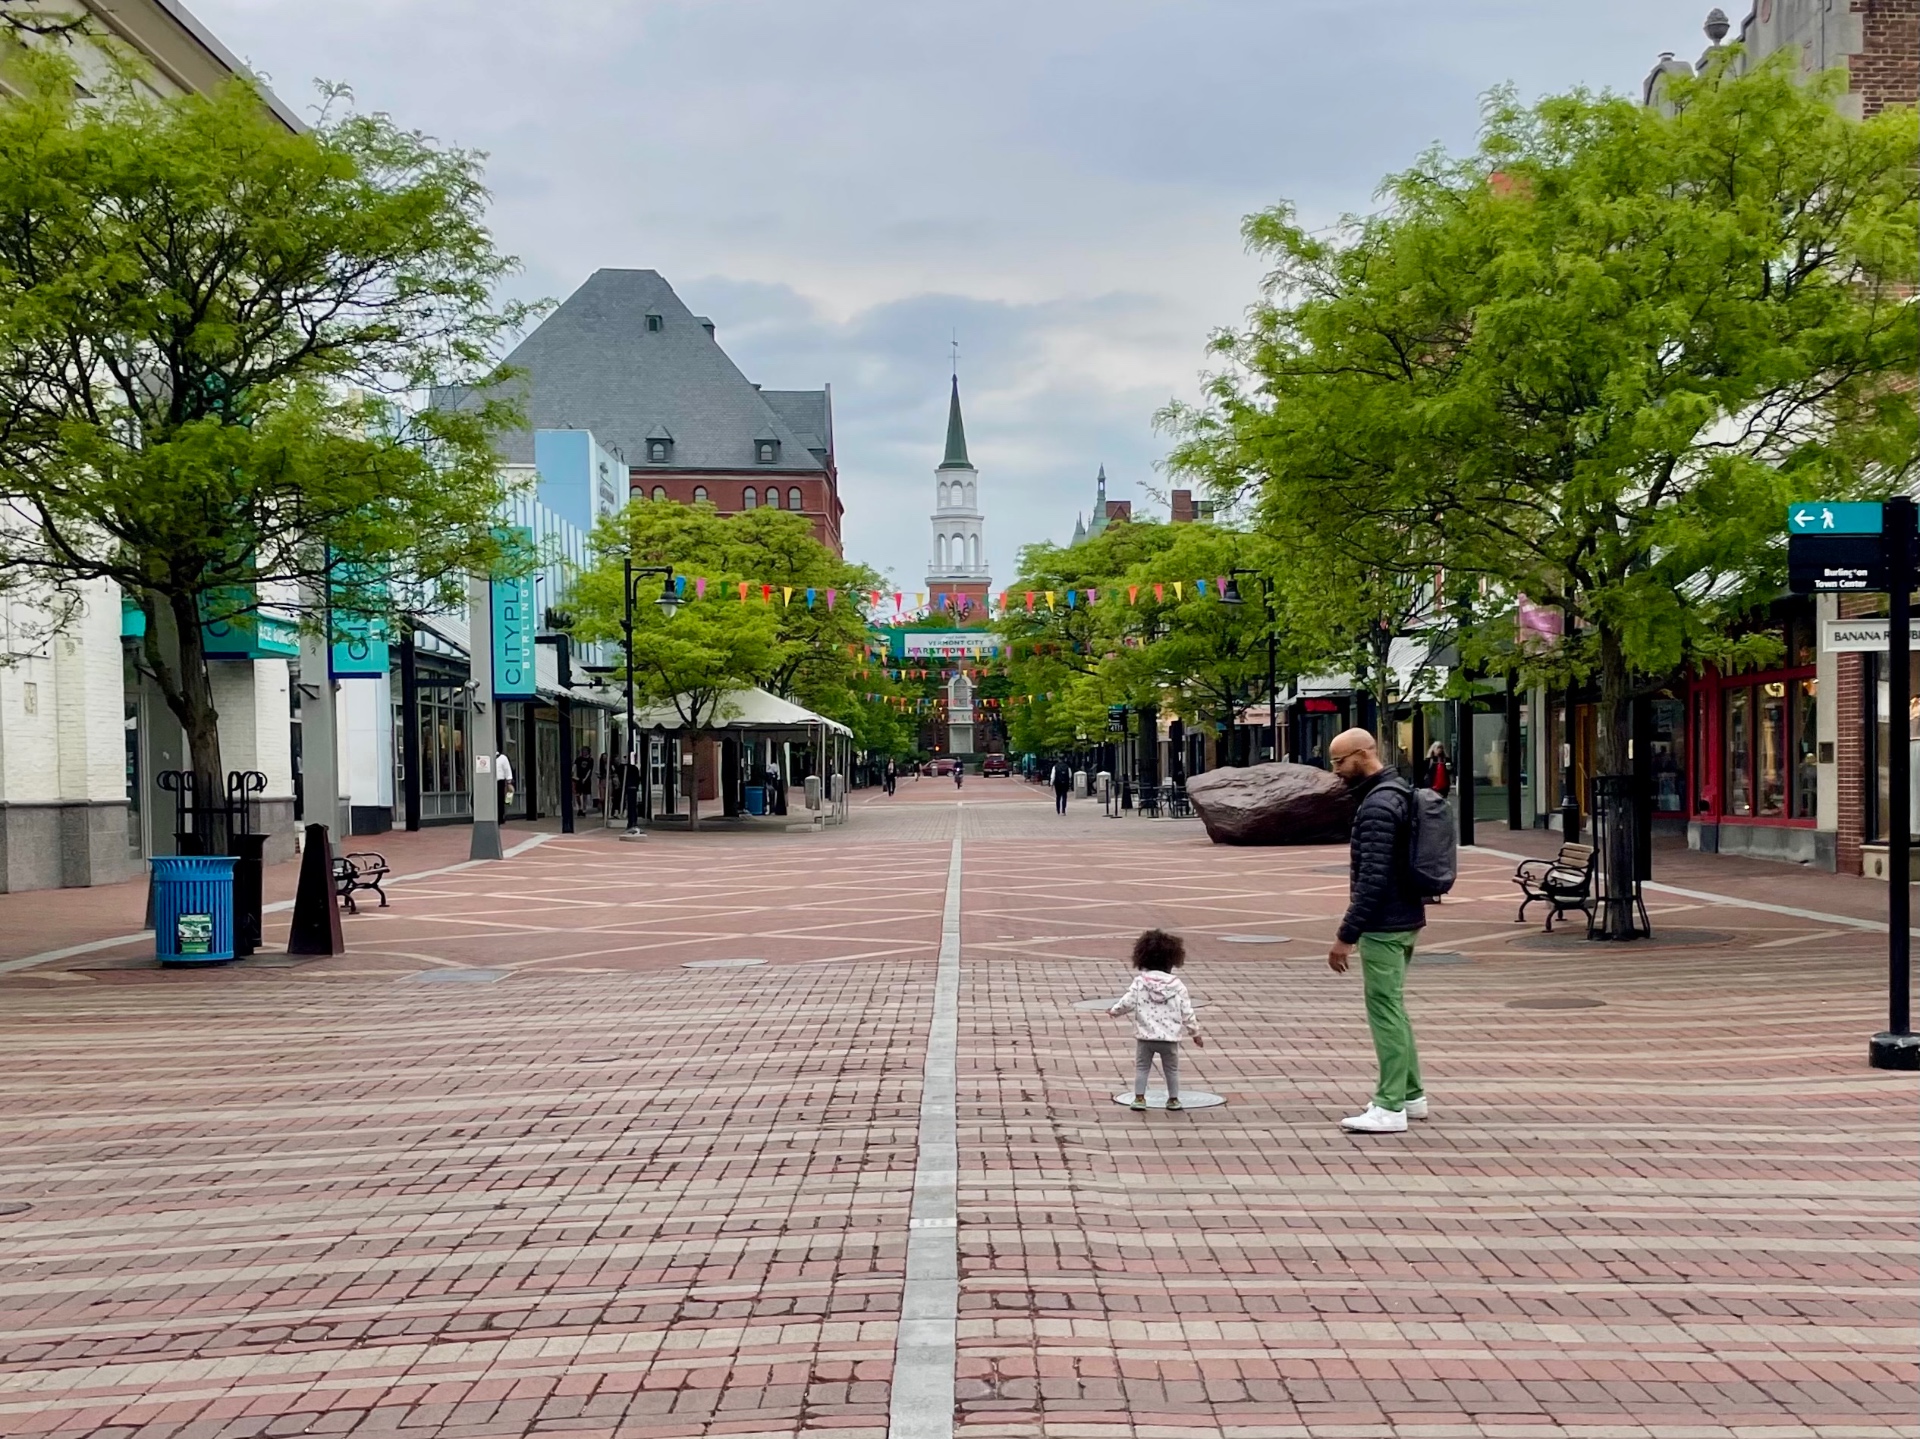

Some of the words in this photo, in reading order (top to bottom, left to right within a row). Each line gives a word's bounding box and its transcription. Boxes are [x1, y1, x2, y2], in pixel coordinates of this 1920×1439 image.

[1824, 569, 1868, 578] Burlington
[1814, 580, 1838, 588] Town
[1839, 580, 1867, 588] Center
[504, 542, 521, 685] CITYPLA
[1834, 631, 1881, 642] BANANA
